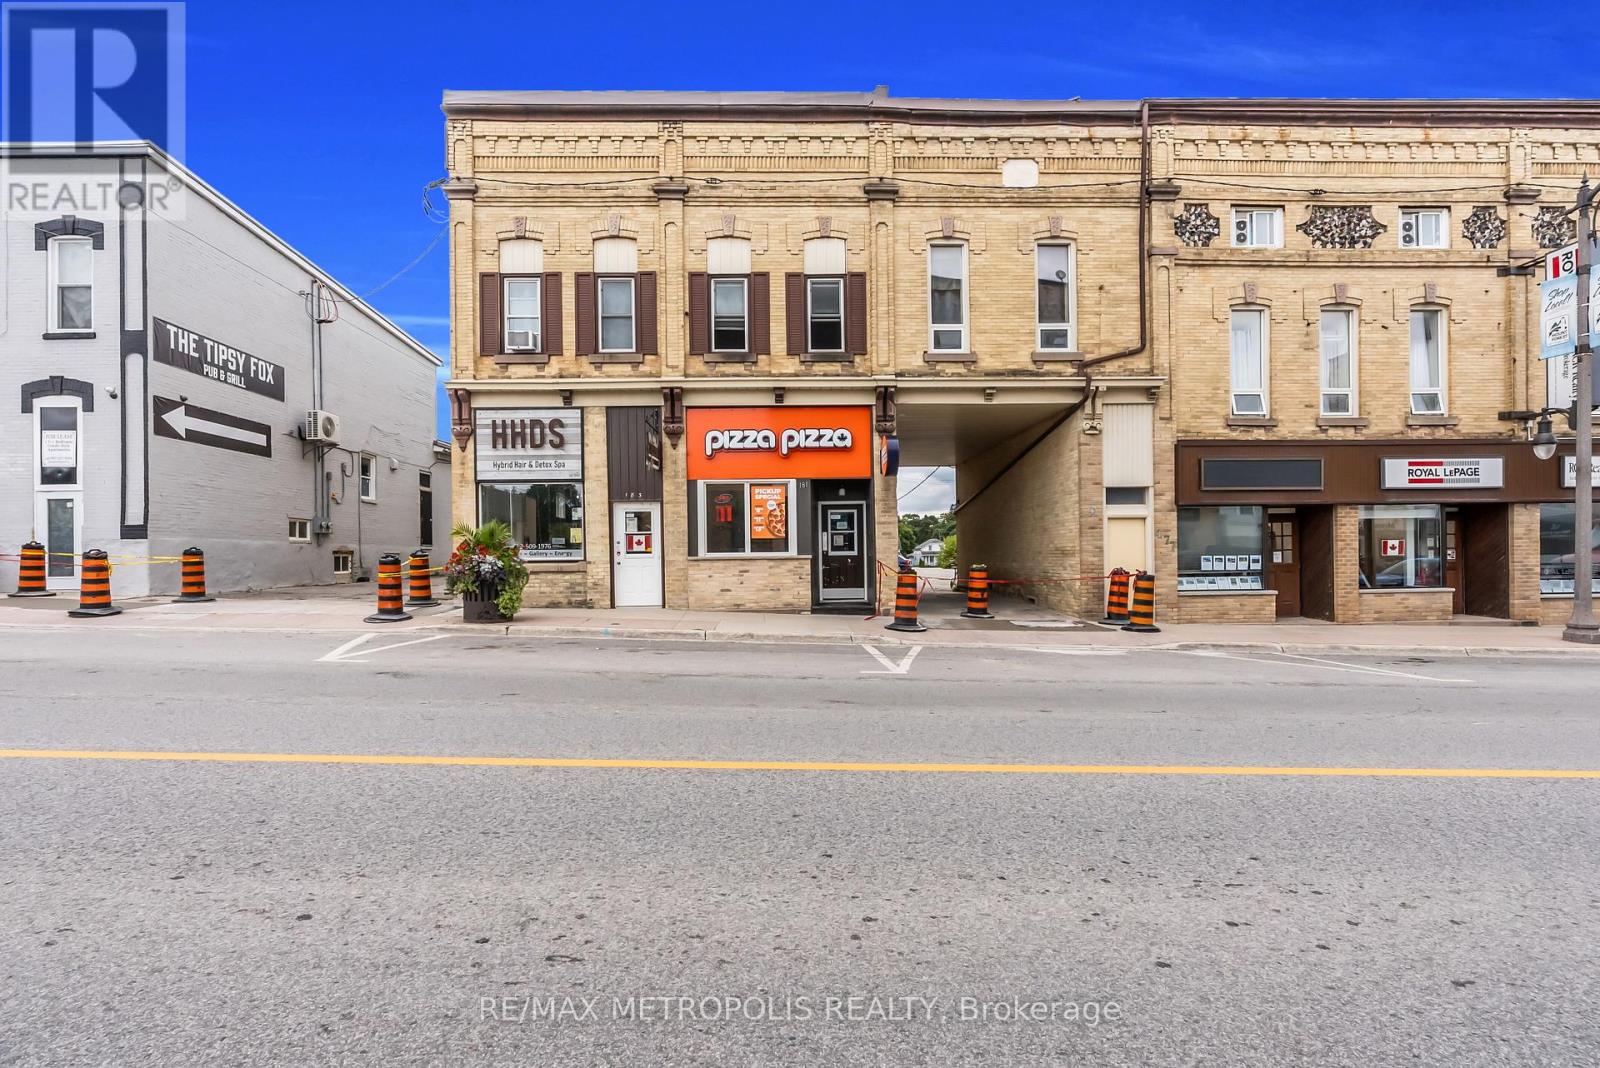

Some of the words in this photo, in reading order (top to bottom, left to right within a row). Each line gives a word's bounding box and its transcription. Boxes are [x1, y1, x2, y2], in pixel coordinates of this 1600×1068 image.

[1561, 250, 1574, 275] RO
[1548, 287, 1570, 300] Shop
[166, 323, 199, 358] THE
[203, 338, 246, 374] TIPSY
[250, 356, 274, 385] FOX
[203, 363, 218, 379] PUB
[219, 370, 226, 381] &
[226, 372, 247, 389] GRILL
[491, 418, 565, 449] HHDS
[492, 460, 513, 470] Hybrid
[514, 460, 527, 468] Hair
[535, 460, 552, 468] Detox
[554, 460, 566, 469] Spa
[1407, 468, 1441, 477] ROYAL
